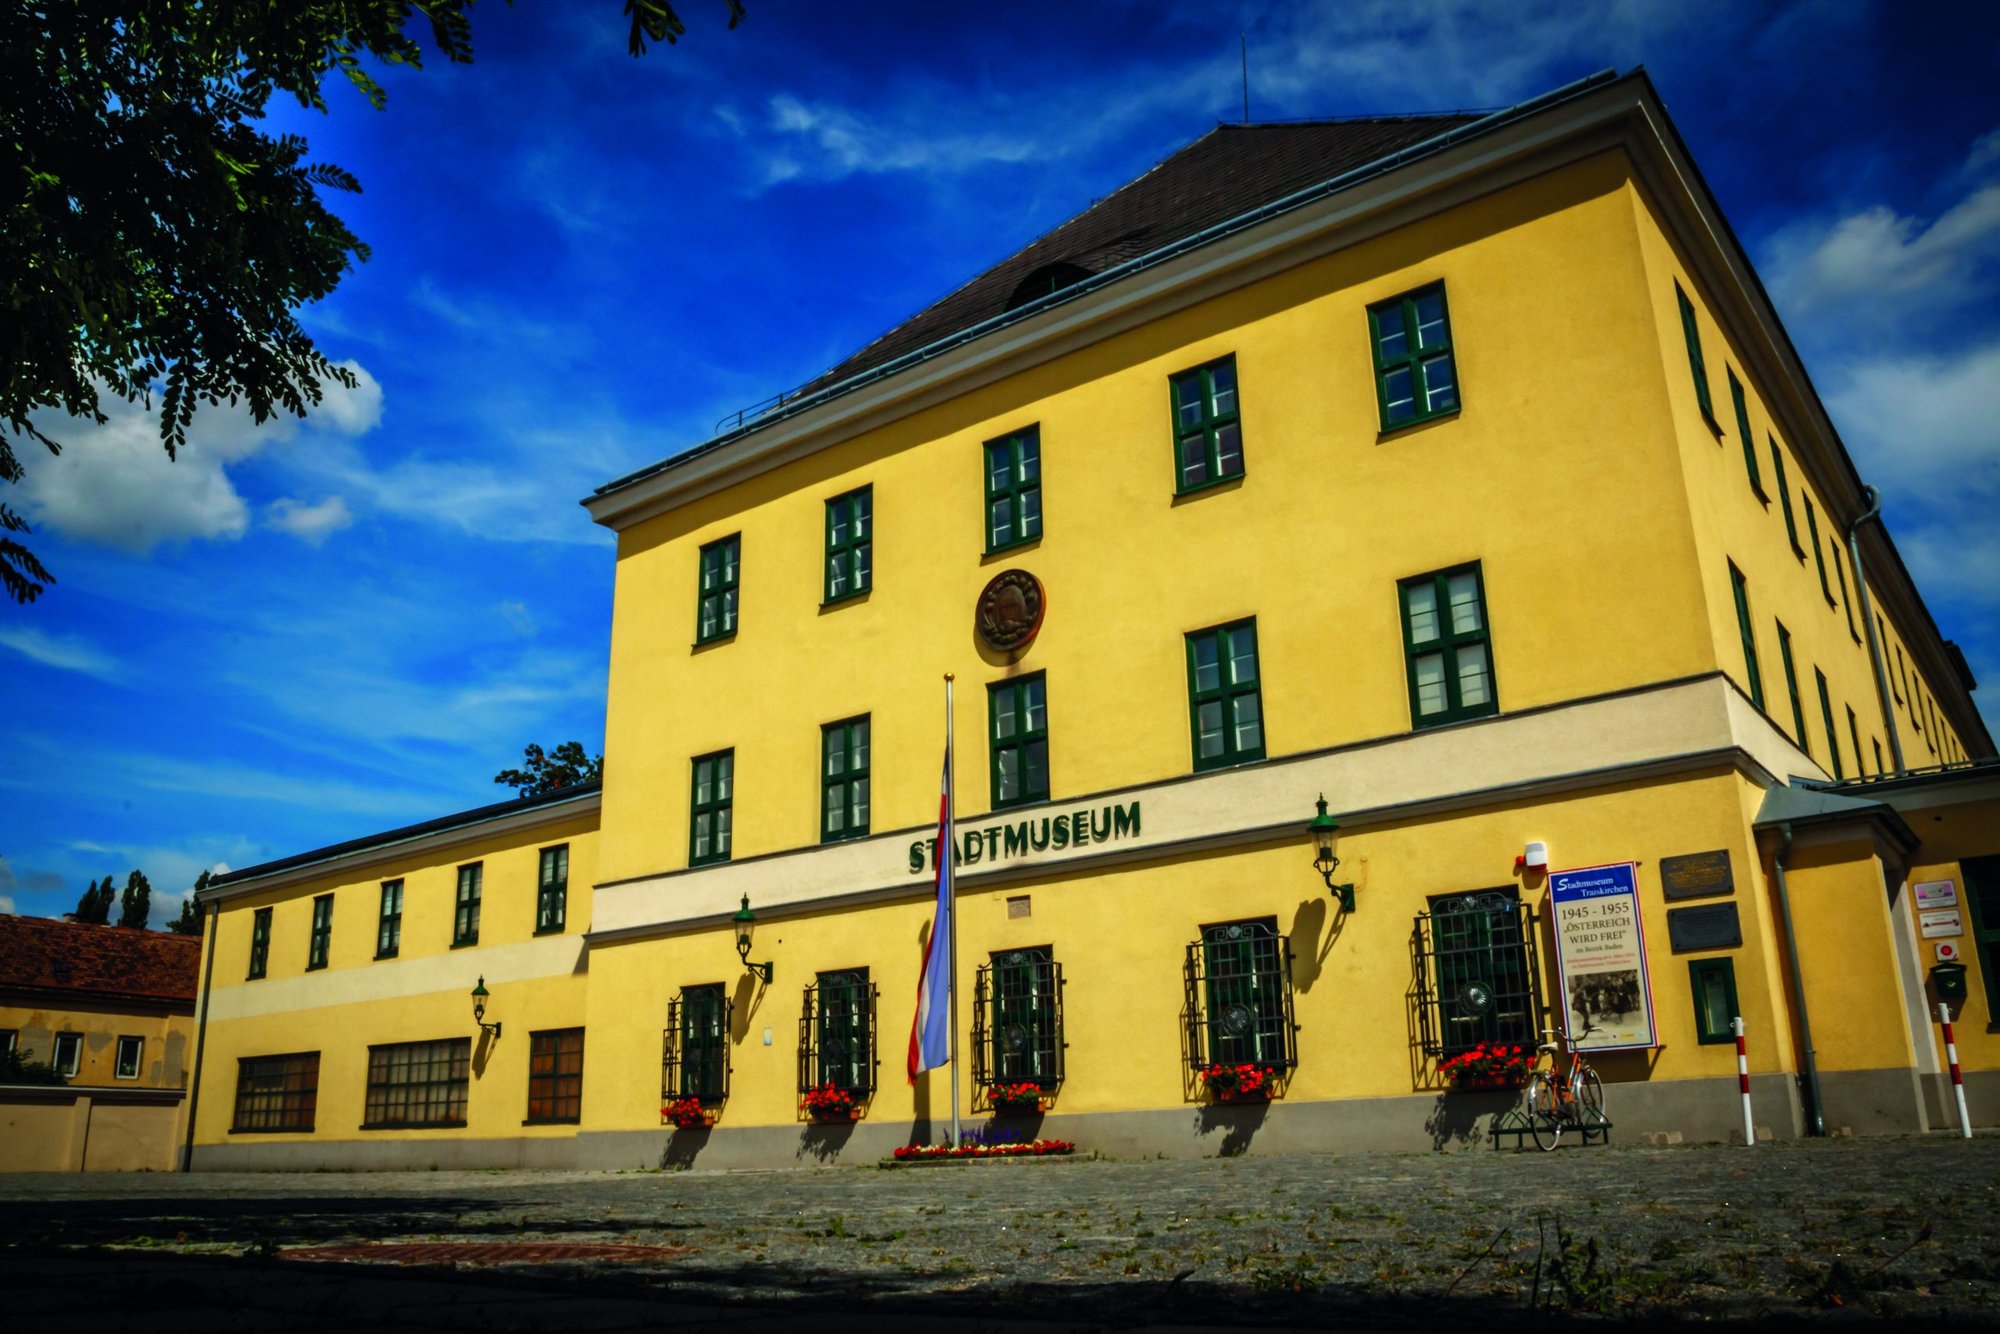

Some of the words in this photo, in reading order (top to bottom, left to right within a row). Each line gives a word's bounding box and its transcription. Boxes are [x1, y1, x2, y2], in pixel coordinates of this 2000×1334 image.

[1557, 878, 1614, 891] Stadtmuseum
[1580, 886, 1629, 897] Traiskirchen
[1562, 907, 1589, 920] 1945
[1601, 902, 1629, 915] 1955
[1569, 934, 1598, 944] WIRD
[1604, 943, 1623, 951] Baden
